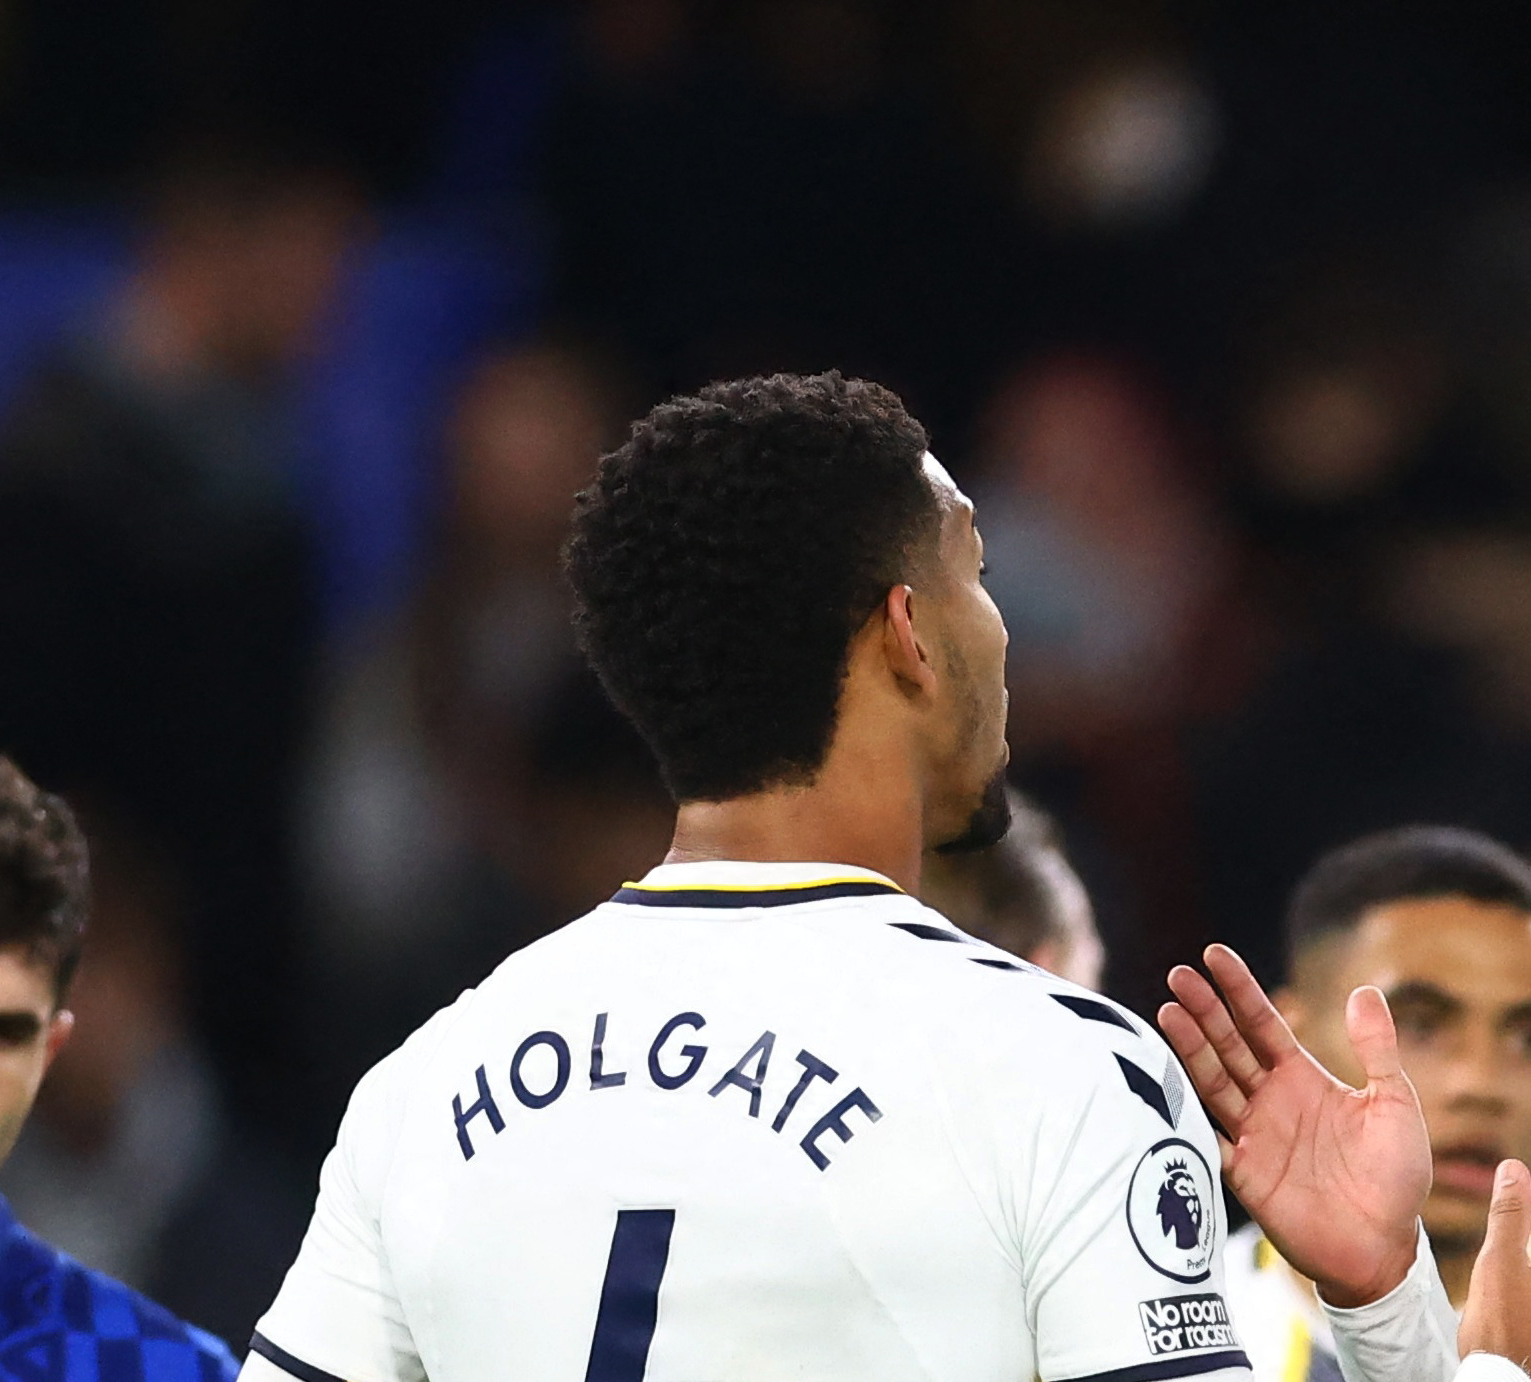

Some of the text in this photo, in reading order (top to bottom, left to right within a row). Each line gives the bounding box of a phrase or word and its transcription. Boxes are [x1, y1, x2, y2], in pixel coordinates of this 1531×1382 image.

[451, 1011, 884, 1172] HOLGATE
[1140, 1299, 1228, 1327] No room
[1146, 1322, 1239, 1353] for racism
